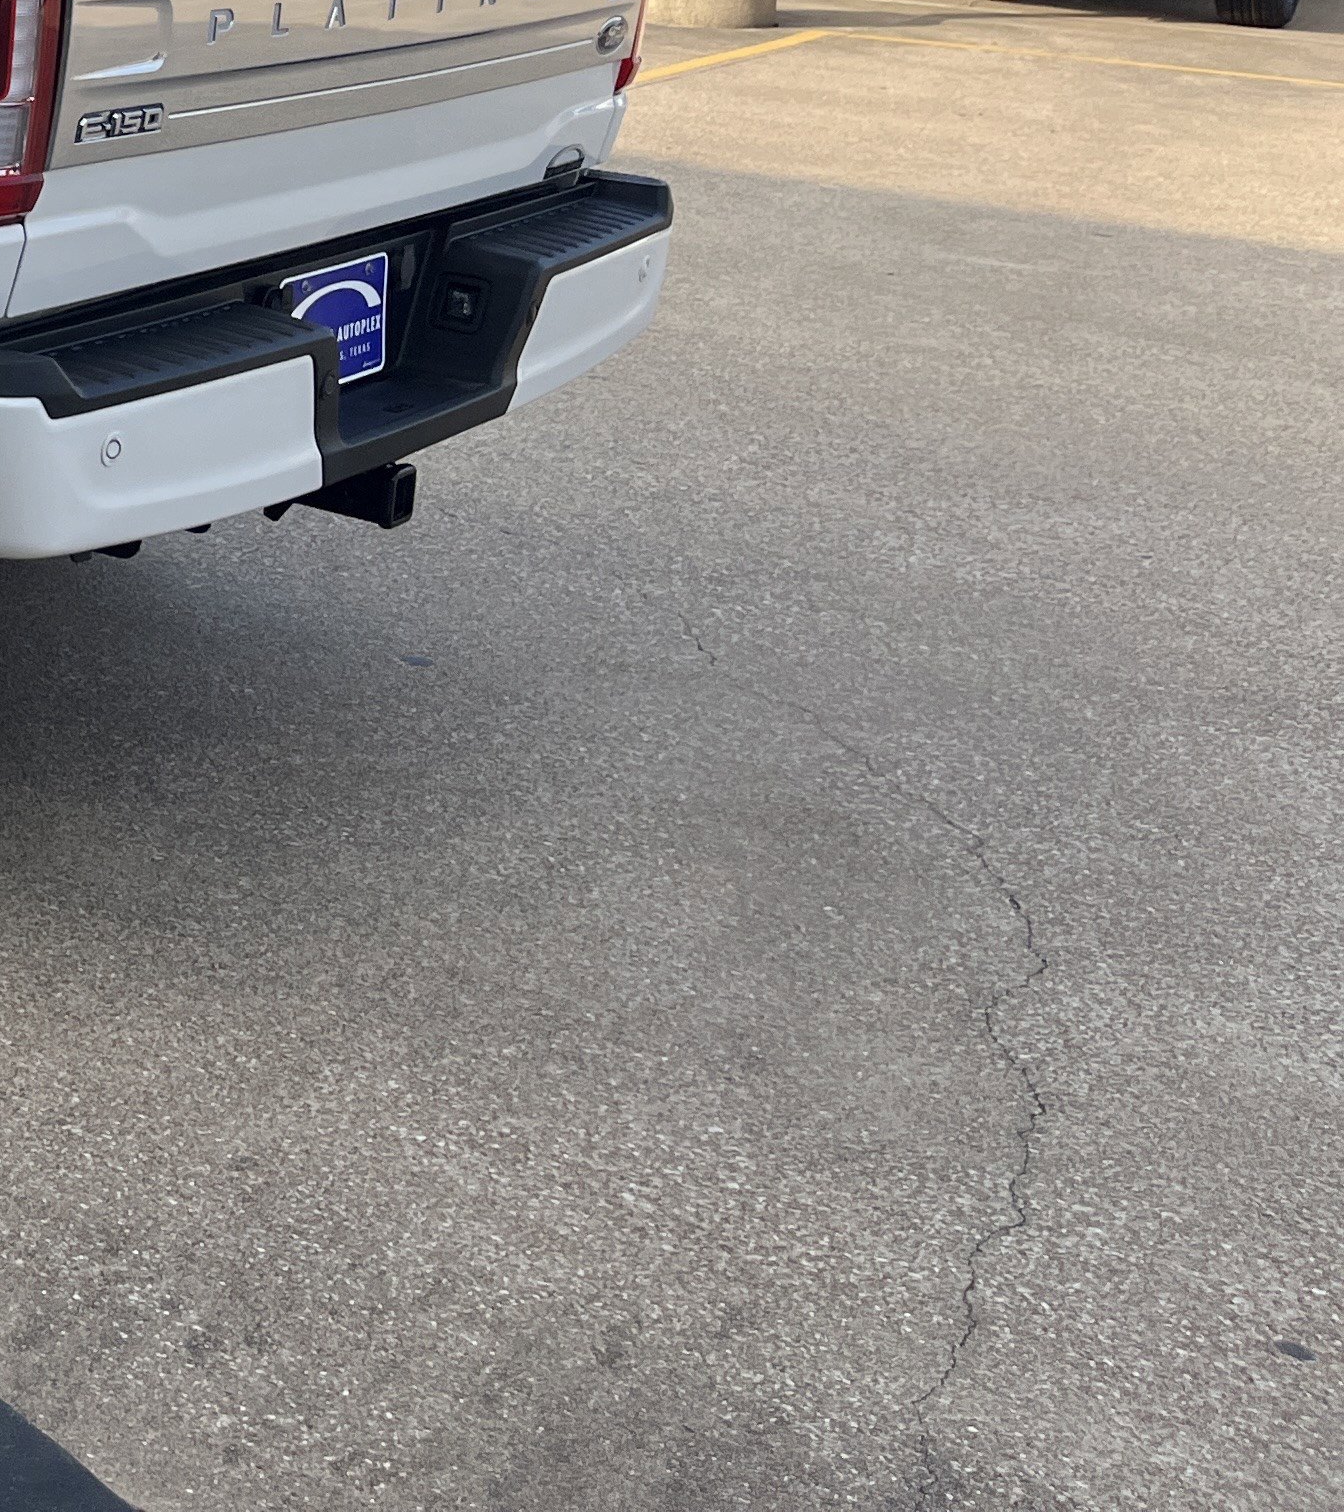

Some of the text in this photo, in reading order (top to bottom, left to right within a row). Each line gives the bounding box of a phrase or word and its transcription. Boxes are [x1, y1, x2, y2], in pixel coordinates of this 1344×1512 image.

[74, 102, 164, 144] F-150
[336, 313, 382, 343] AUTOPLEX
[349, 341, 372, 357] TEXAS
